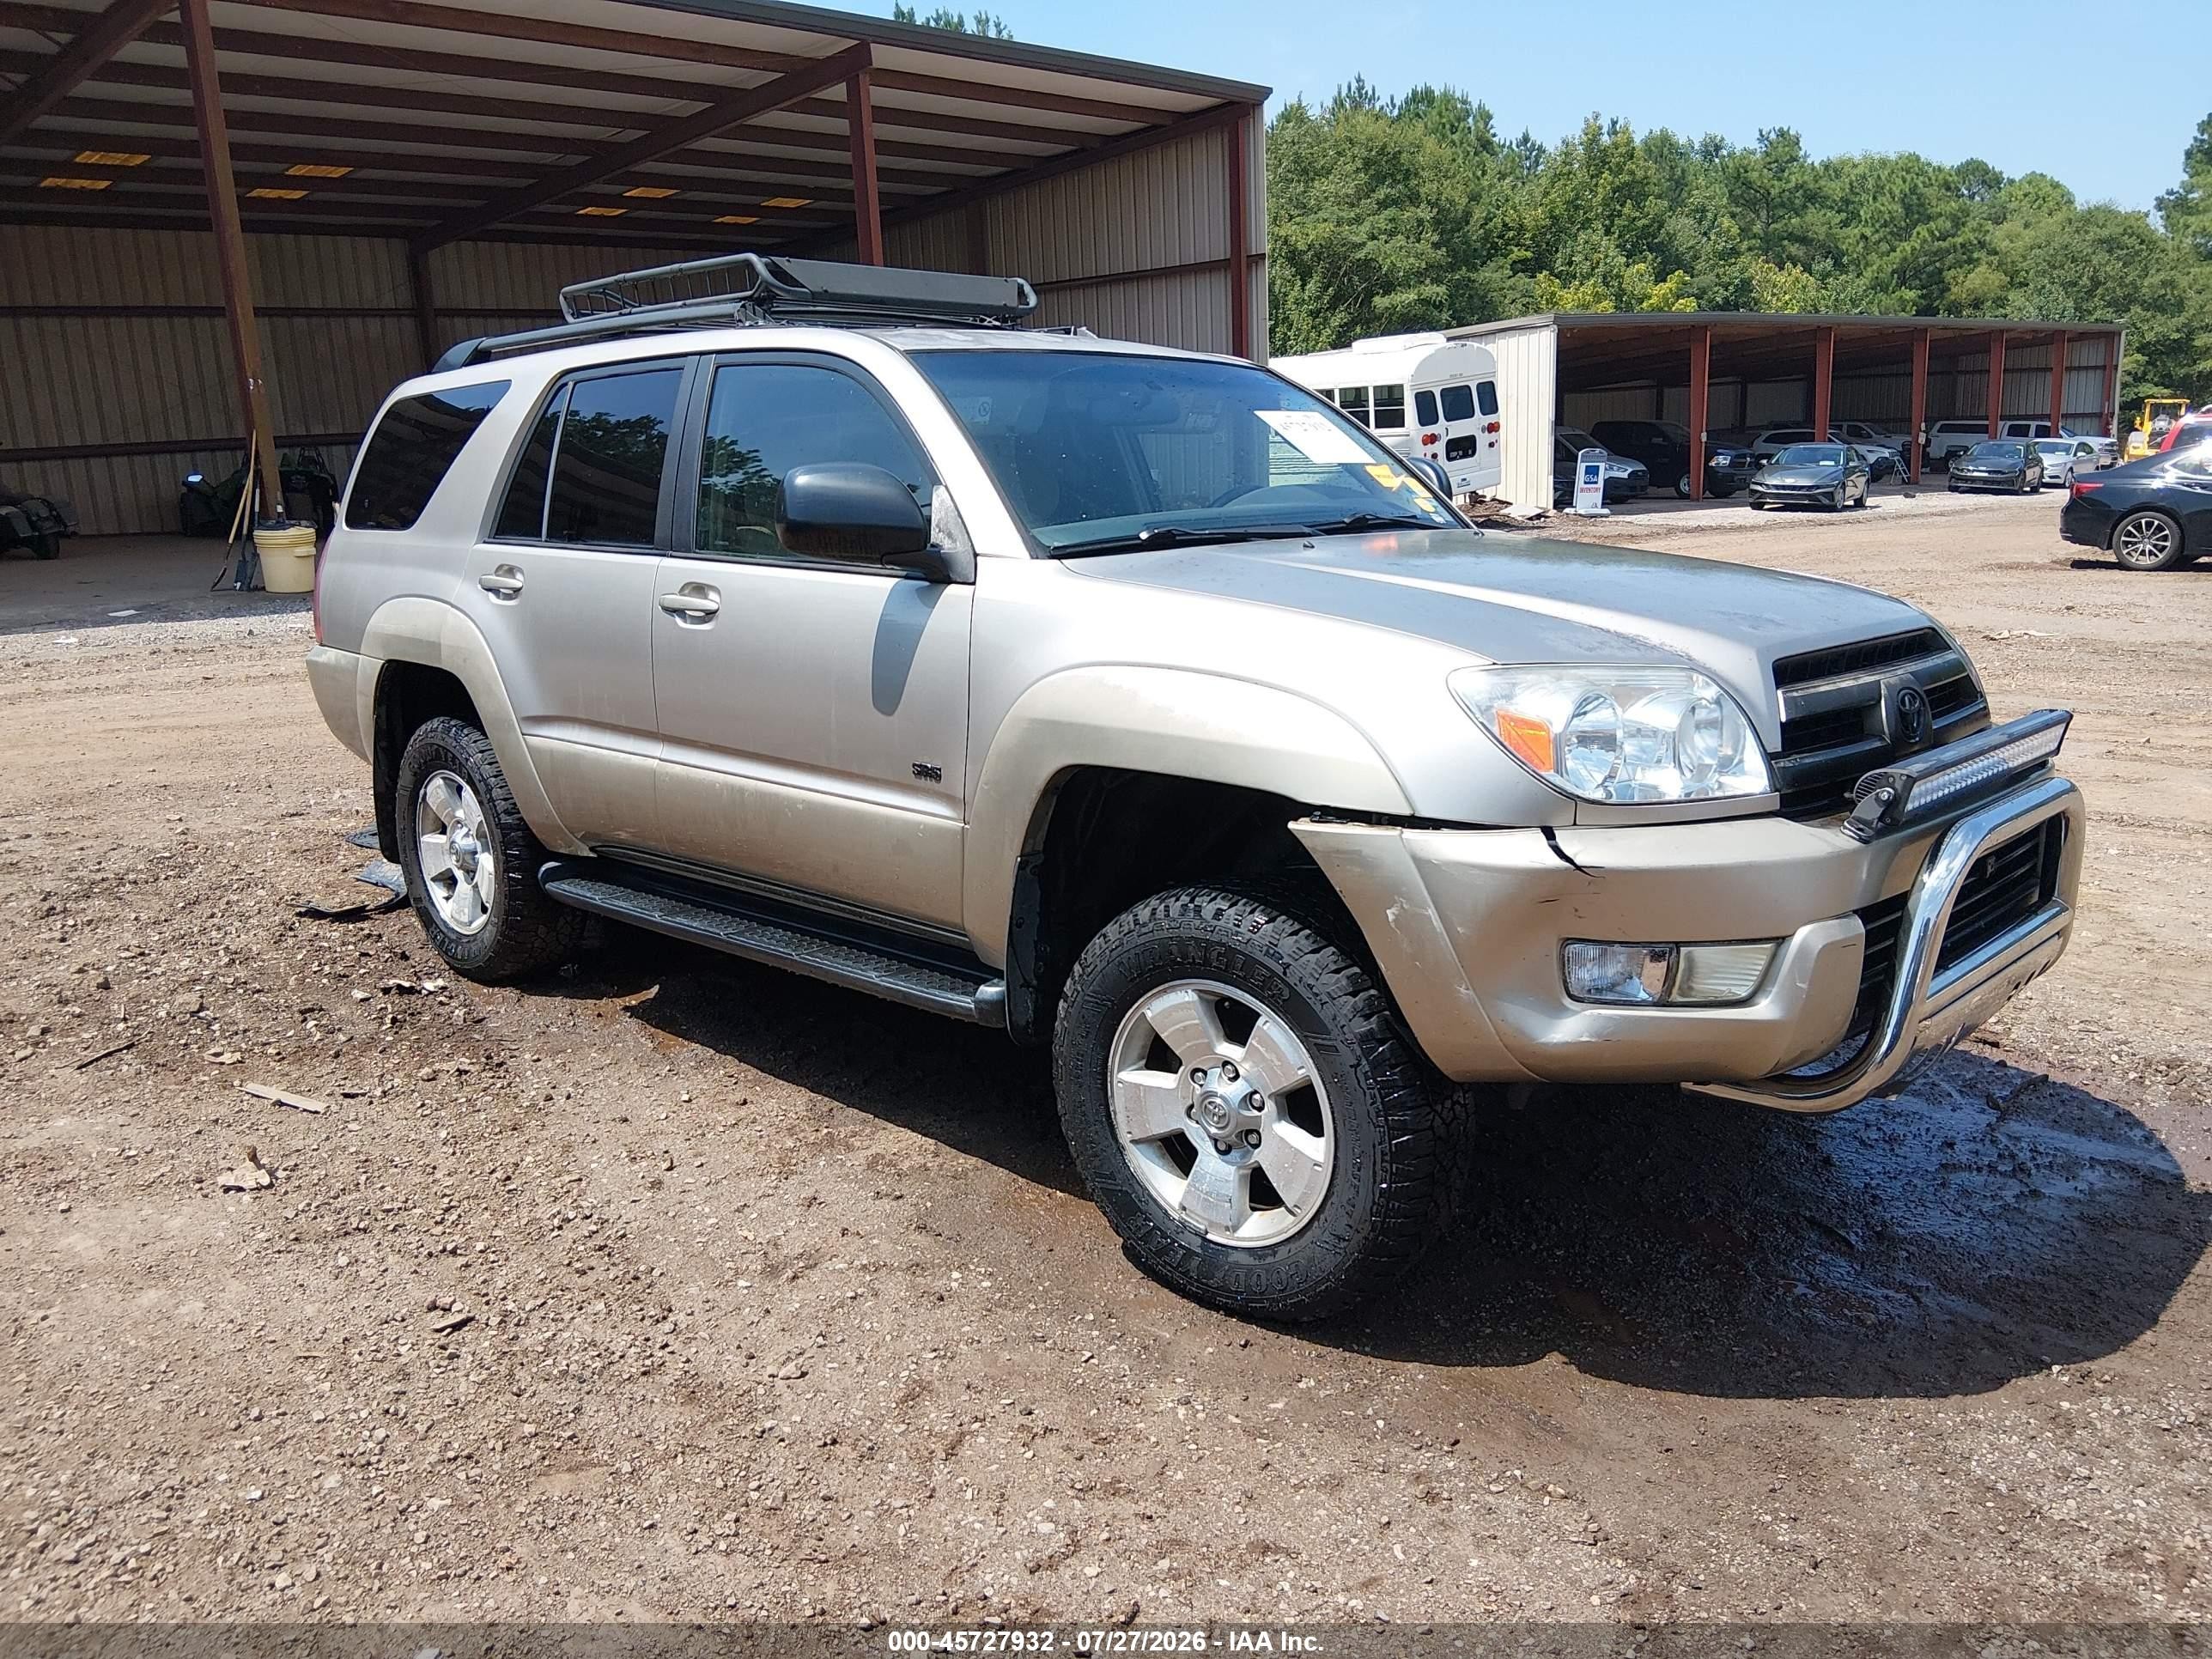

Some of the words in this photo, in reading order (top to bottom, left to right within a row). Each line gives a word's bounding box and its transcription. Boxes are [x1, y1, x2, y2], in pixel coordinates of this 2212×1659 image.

[1584, 474, 1598, 483] GSA
[912, 761, 942, 782] SR5
[1118, 936, 1291, 1006] WRANGLER
